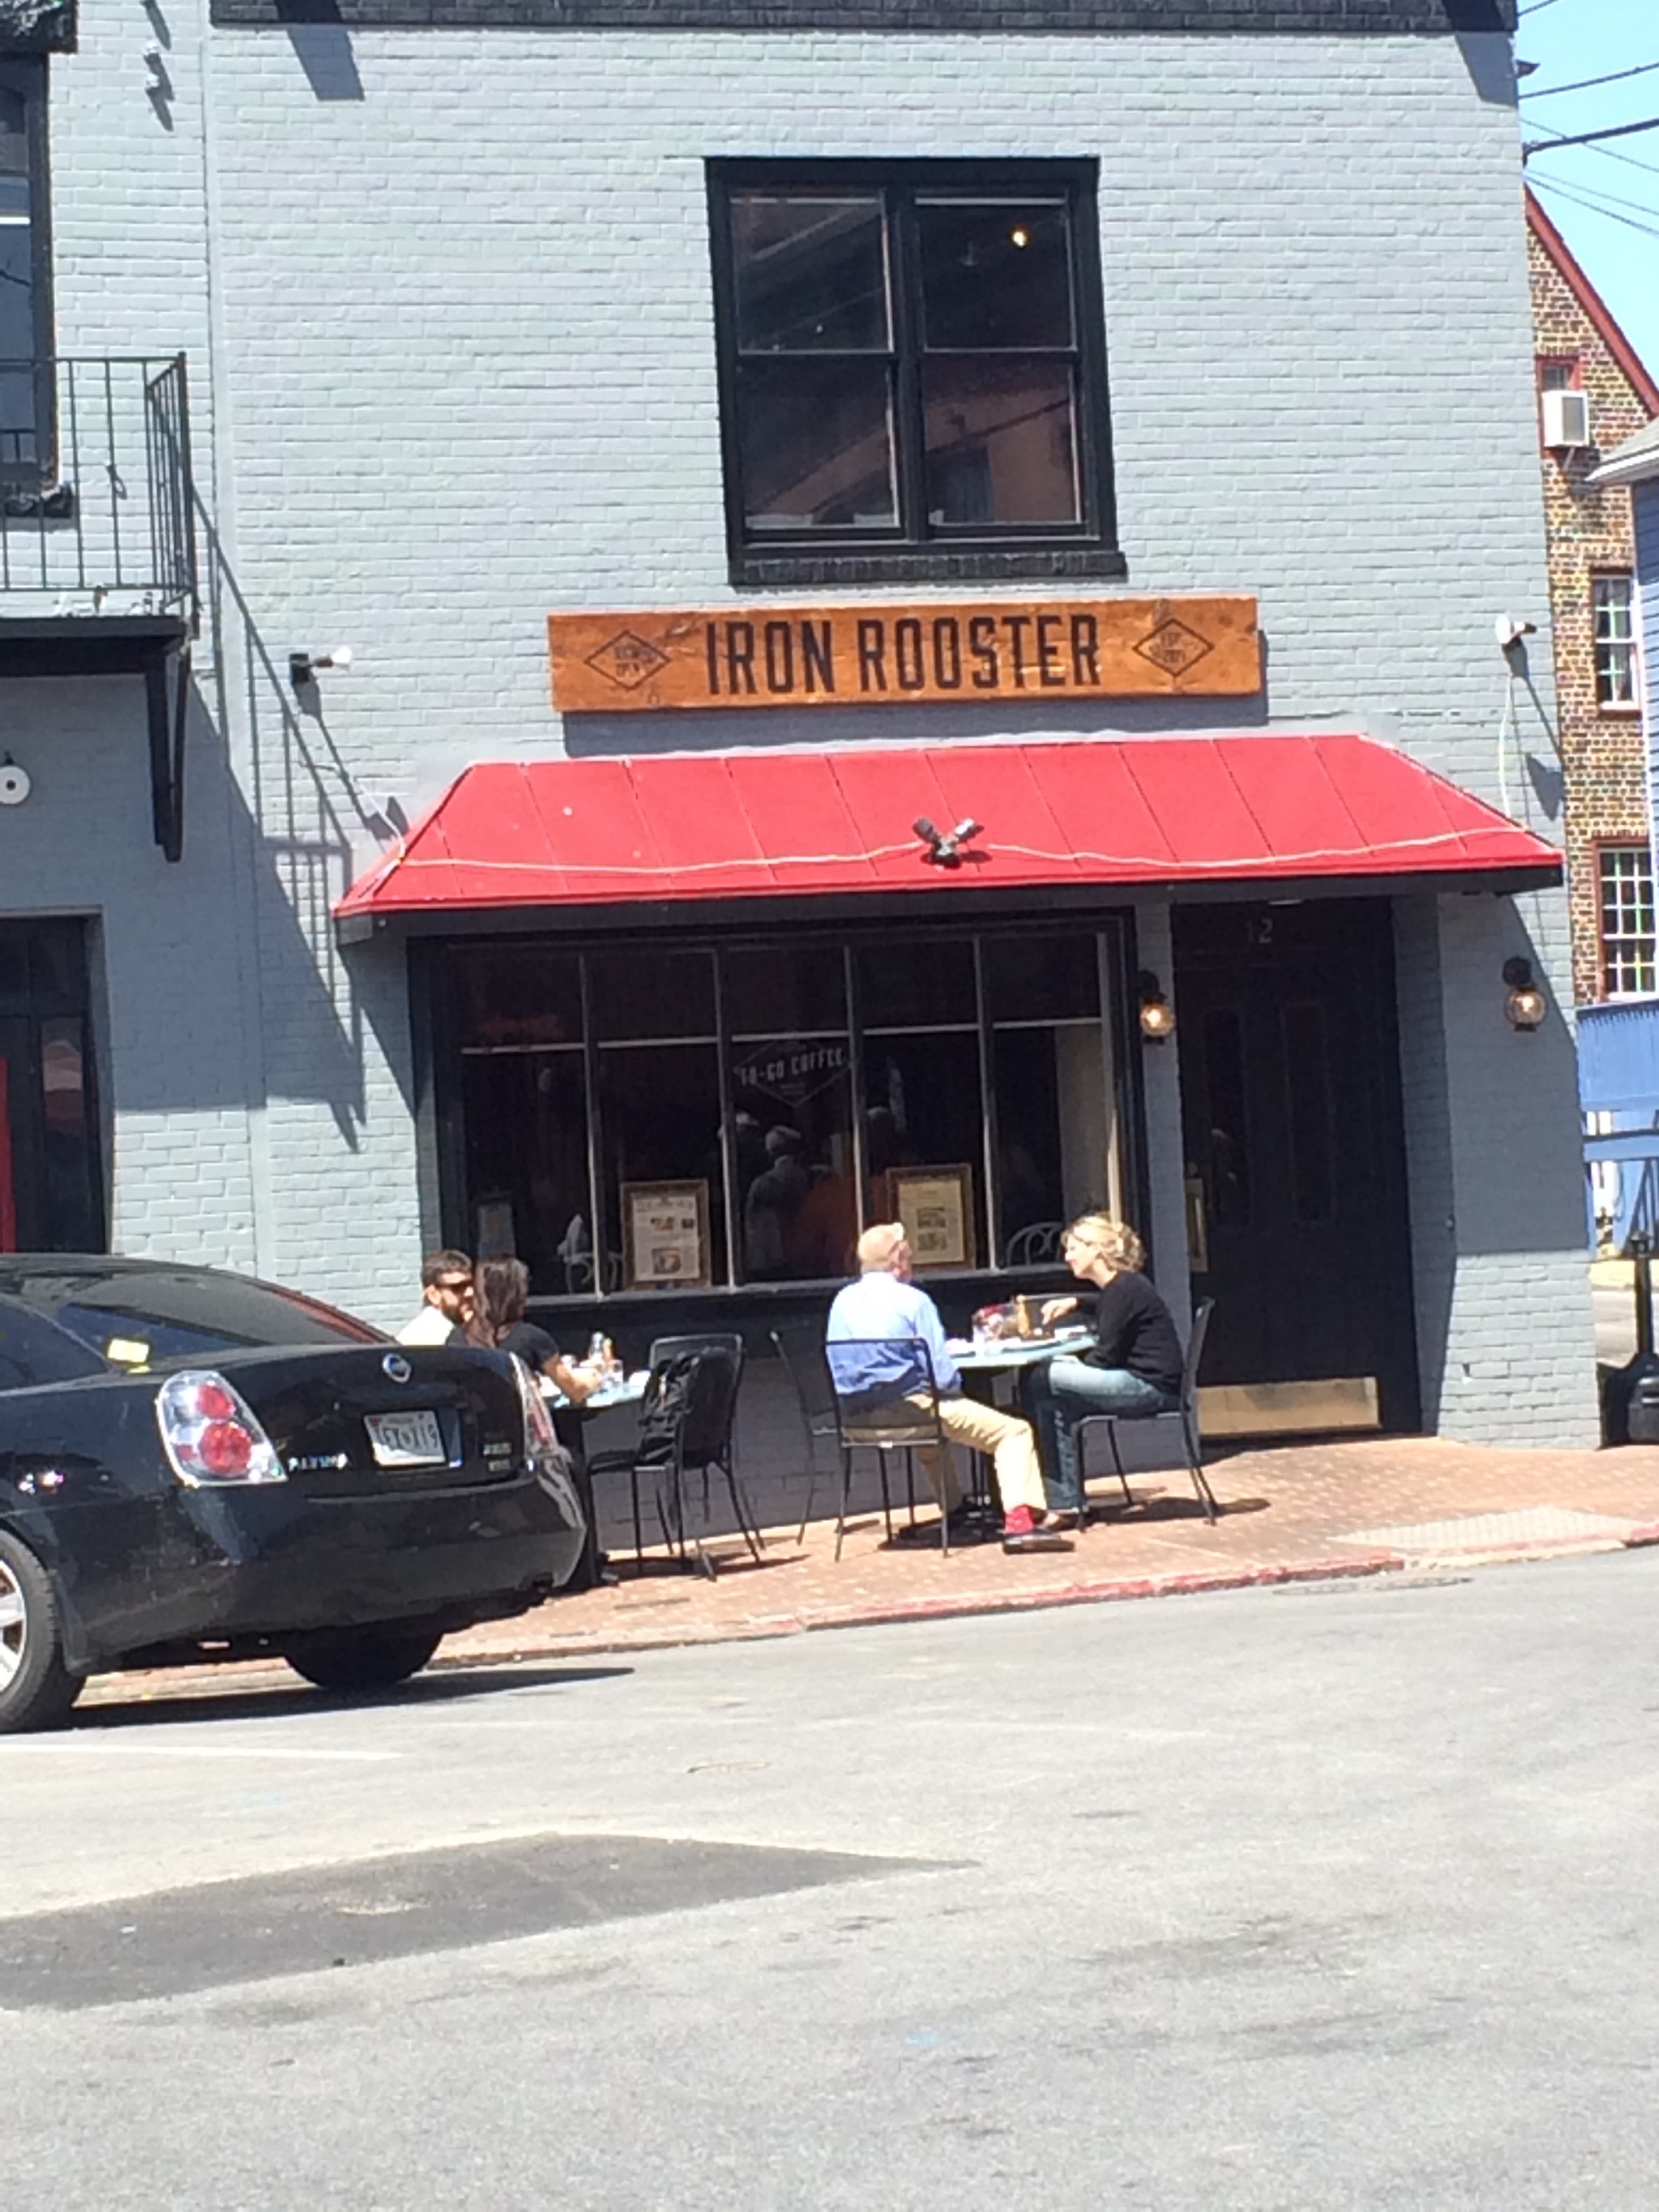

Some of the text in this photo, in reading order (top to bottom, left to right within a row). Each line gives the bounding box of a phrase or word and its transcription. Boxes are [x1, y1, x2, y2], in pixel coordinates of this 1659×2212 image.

[706, 619, 836, 695] IRON
[857, 613, 1101, 692] ROOSTER
[1246, 918, 1273, 944] 12
[740, 1047, 842, 1087] TO-GO COFFEE
